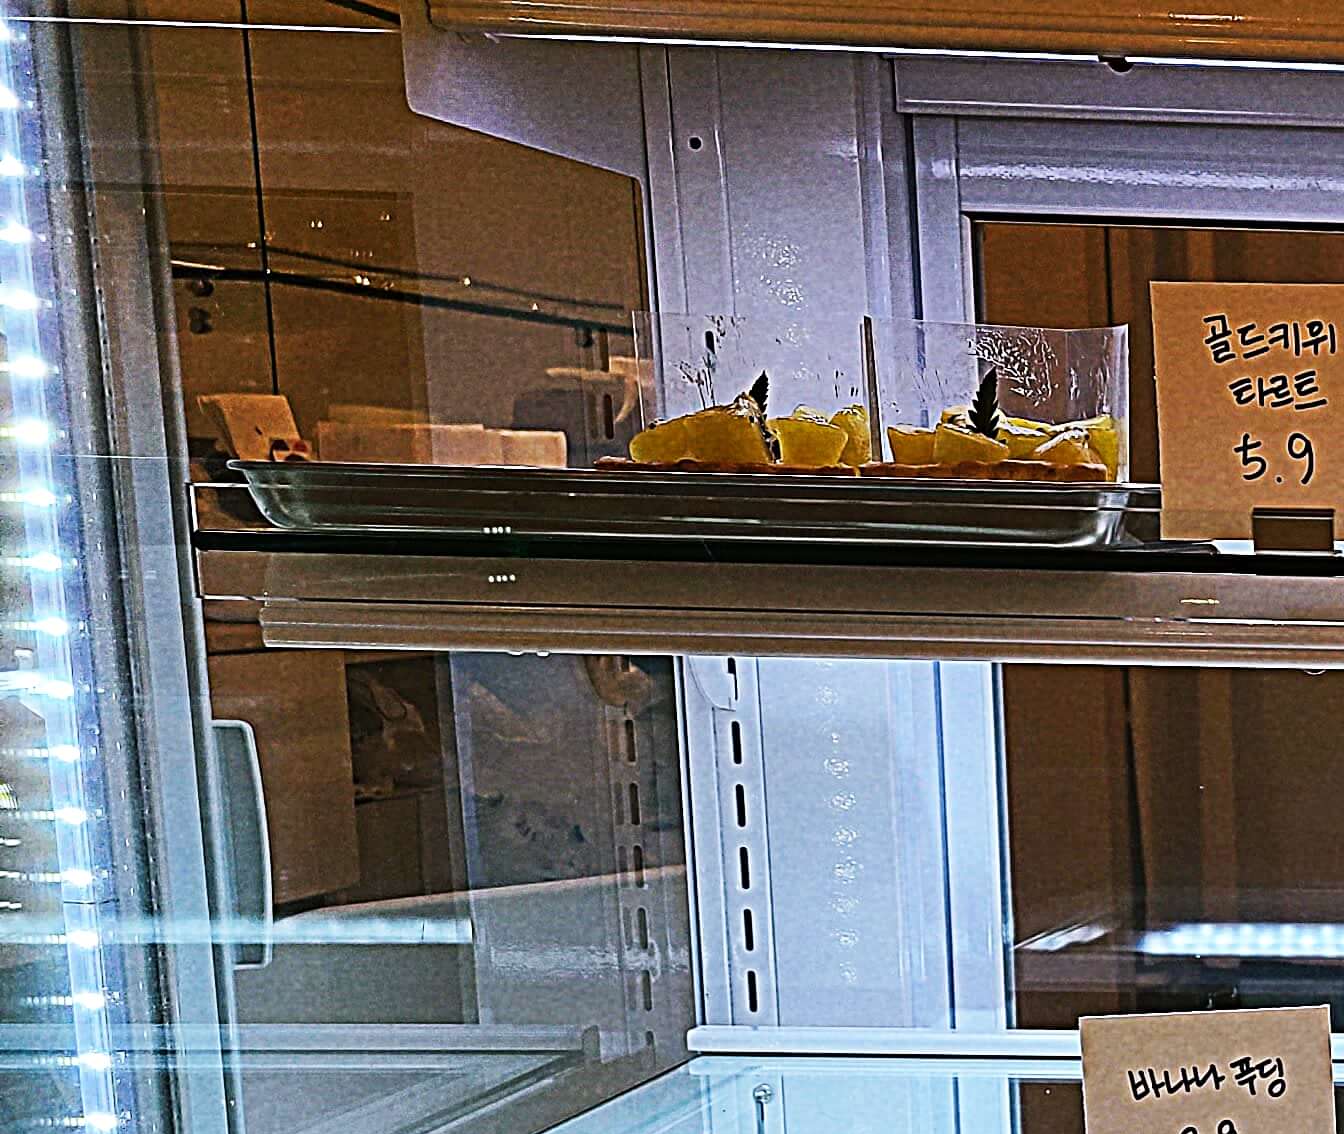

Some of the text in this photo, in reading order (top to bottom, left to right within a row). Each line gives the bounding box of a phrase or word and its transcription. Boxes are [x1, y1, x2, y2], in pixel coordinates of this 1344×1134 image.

[1202, 314, 1336, 363] 골드키위
[1229, 370, 1328, 411] 타르트
[1234, 432, 1316, 485] 5.9
[1128, 1056, 1286, 1101] 바나나 푸딩
